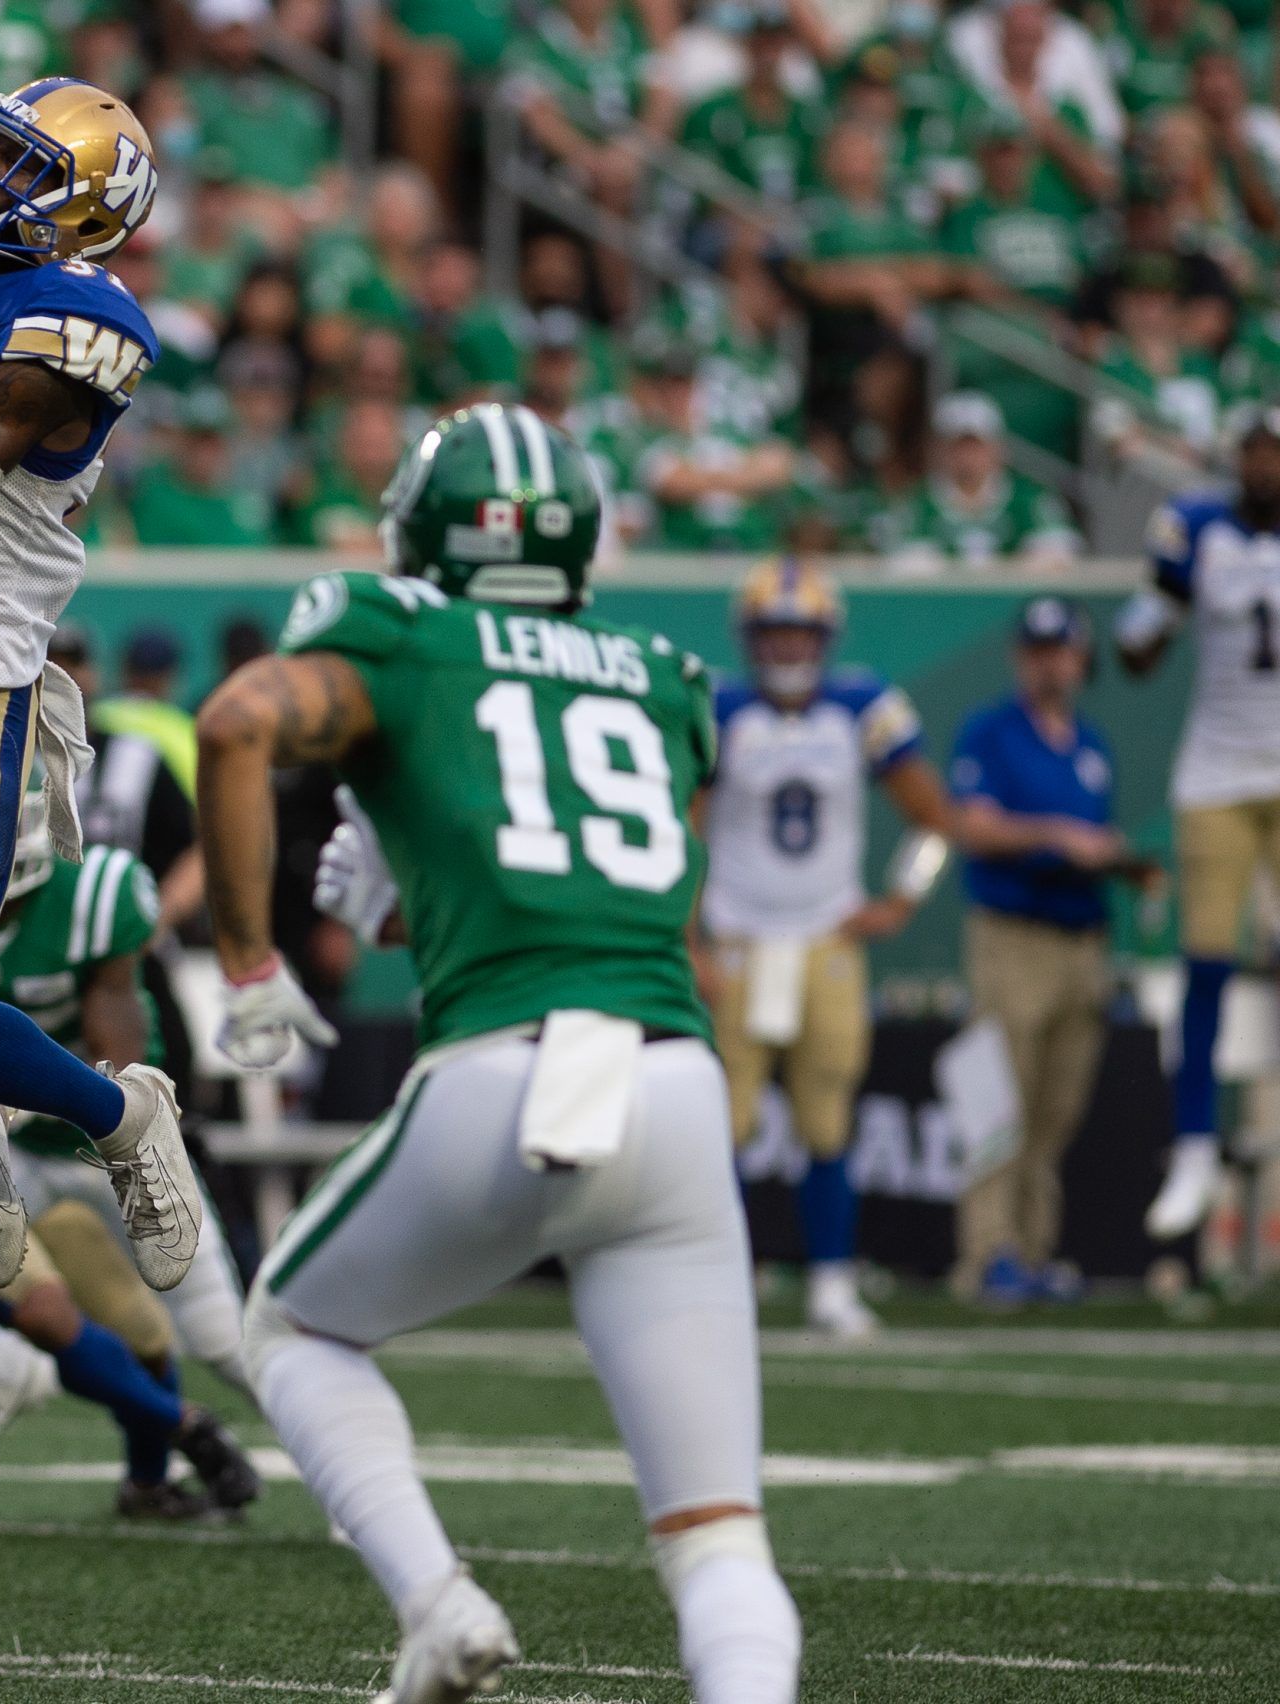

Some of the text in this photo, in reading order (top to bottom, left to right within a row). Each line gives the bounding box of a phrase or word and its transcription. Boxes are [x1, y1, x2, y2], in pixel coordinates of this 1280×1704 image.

[101, 132, 158, 230] W
[62, 315, 145, 393] W
[475, 608, 651, 696] LENIUS
[475, 679, 688, 894] 19
[771, 778, 818, 857] 8
